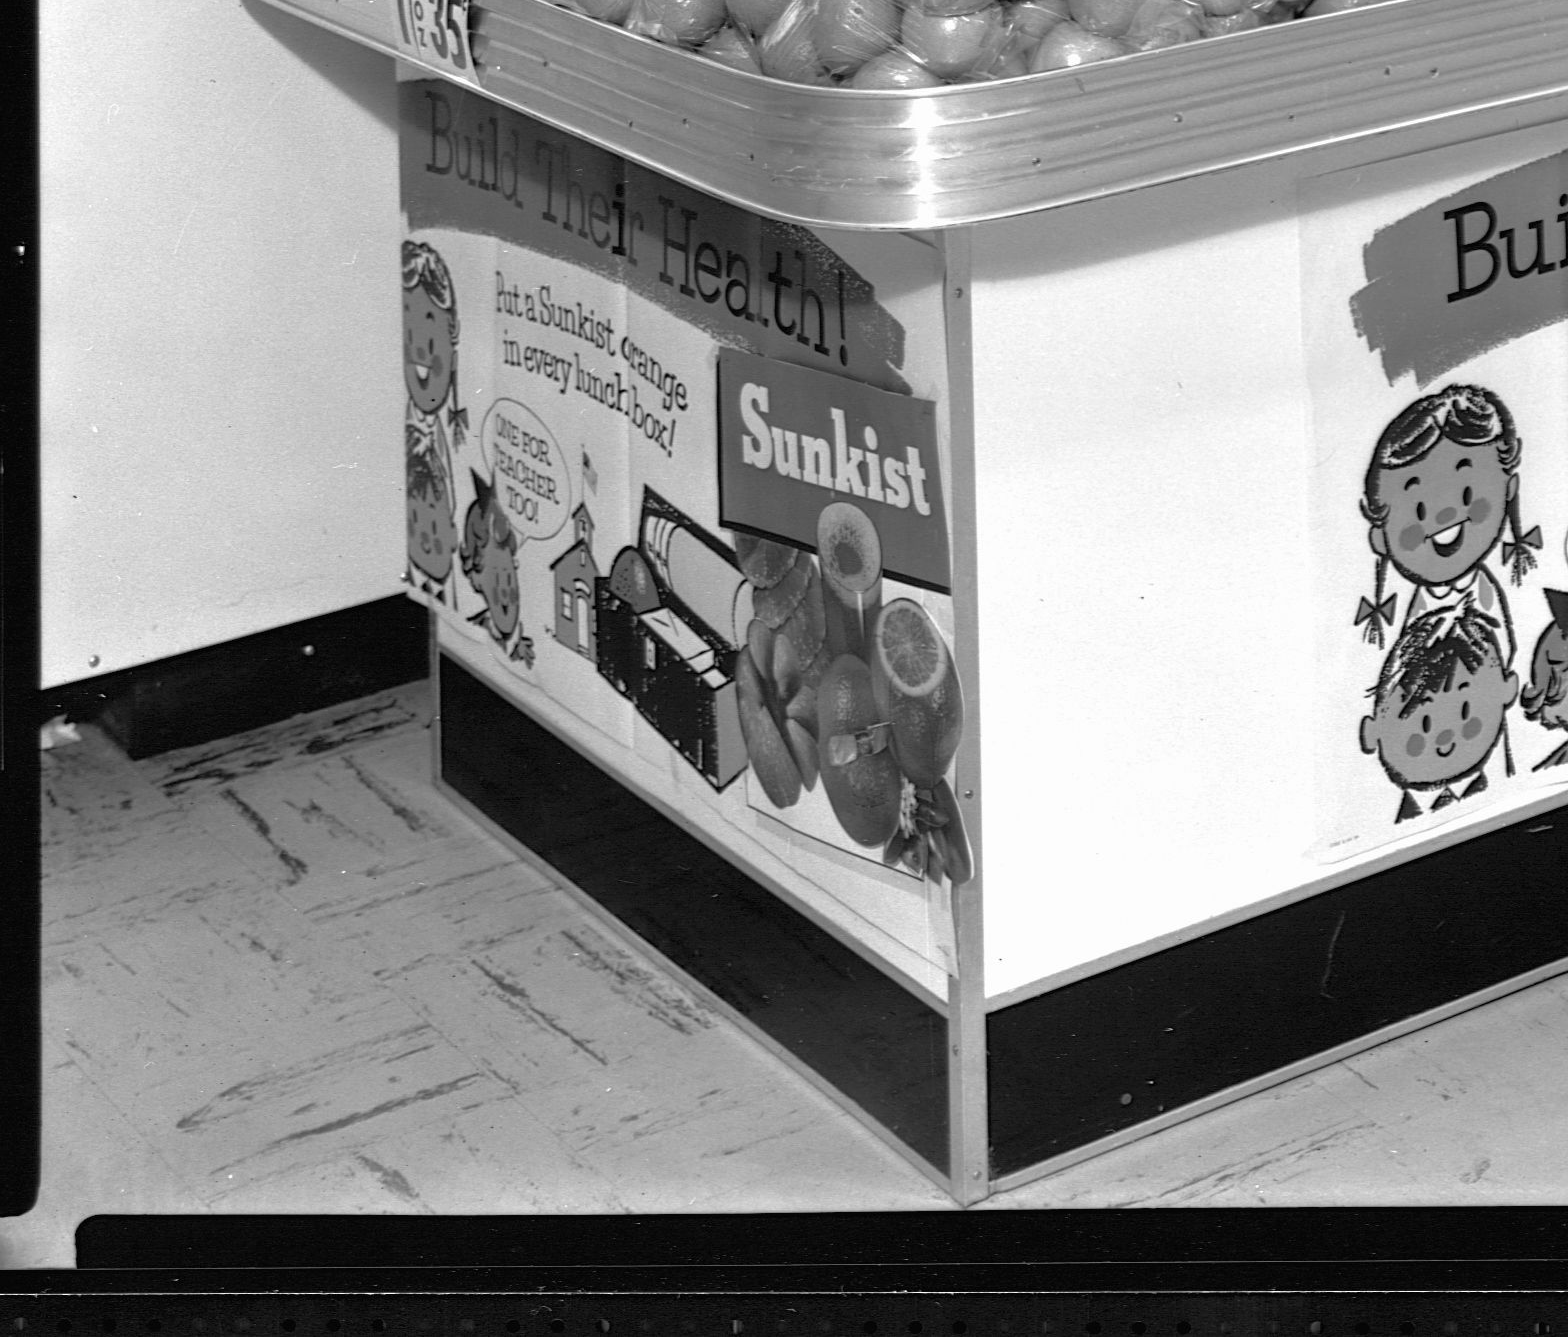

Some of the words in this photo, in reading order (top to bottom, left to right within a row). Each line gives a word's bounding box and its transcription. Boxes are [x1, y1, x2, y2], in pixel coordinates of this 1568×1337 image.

[424, 87, 525, 210] Build
[536, 137, 646, 268] Their
[657, 191, 852, 368] Health!
[494, 267, 523, 322] Put
[524, 300, 538, 325] a
[537, 284, 617, 361] Sunkist
[618, 331, 690, 412] orange
[501, 328, 521, 368] in
[520, 343, 573, 396] every
[572, 351, 630, 427] lunch
[629, 381, 678, 461] box!
[490, 445, 561, 506] TEACHER
[494, 416, 520, 449] ONE
[520, 424, 551, 467] FOR
[505, 475, 541, 526] TOO!
[741, 381, 932, 518] Sunkist
